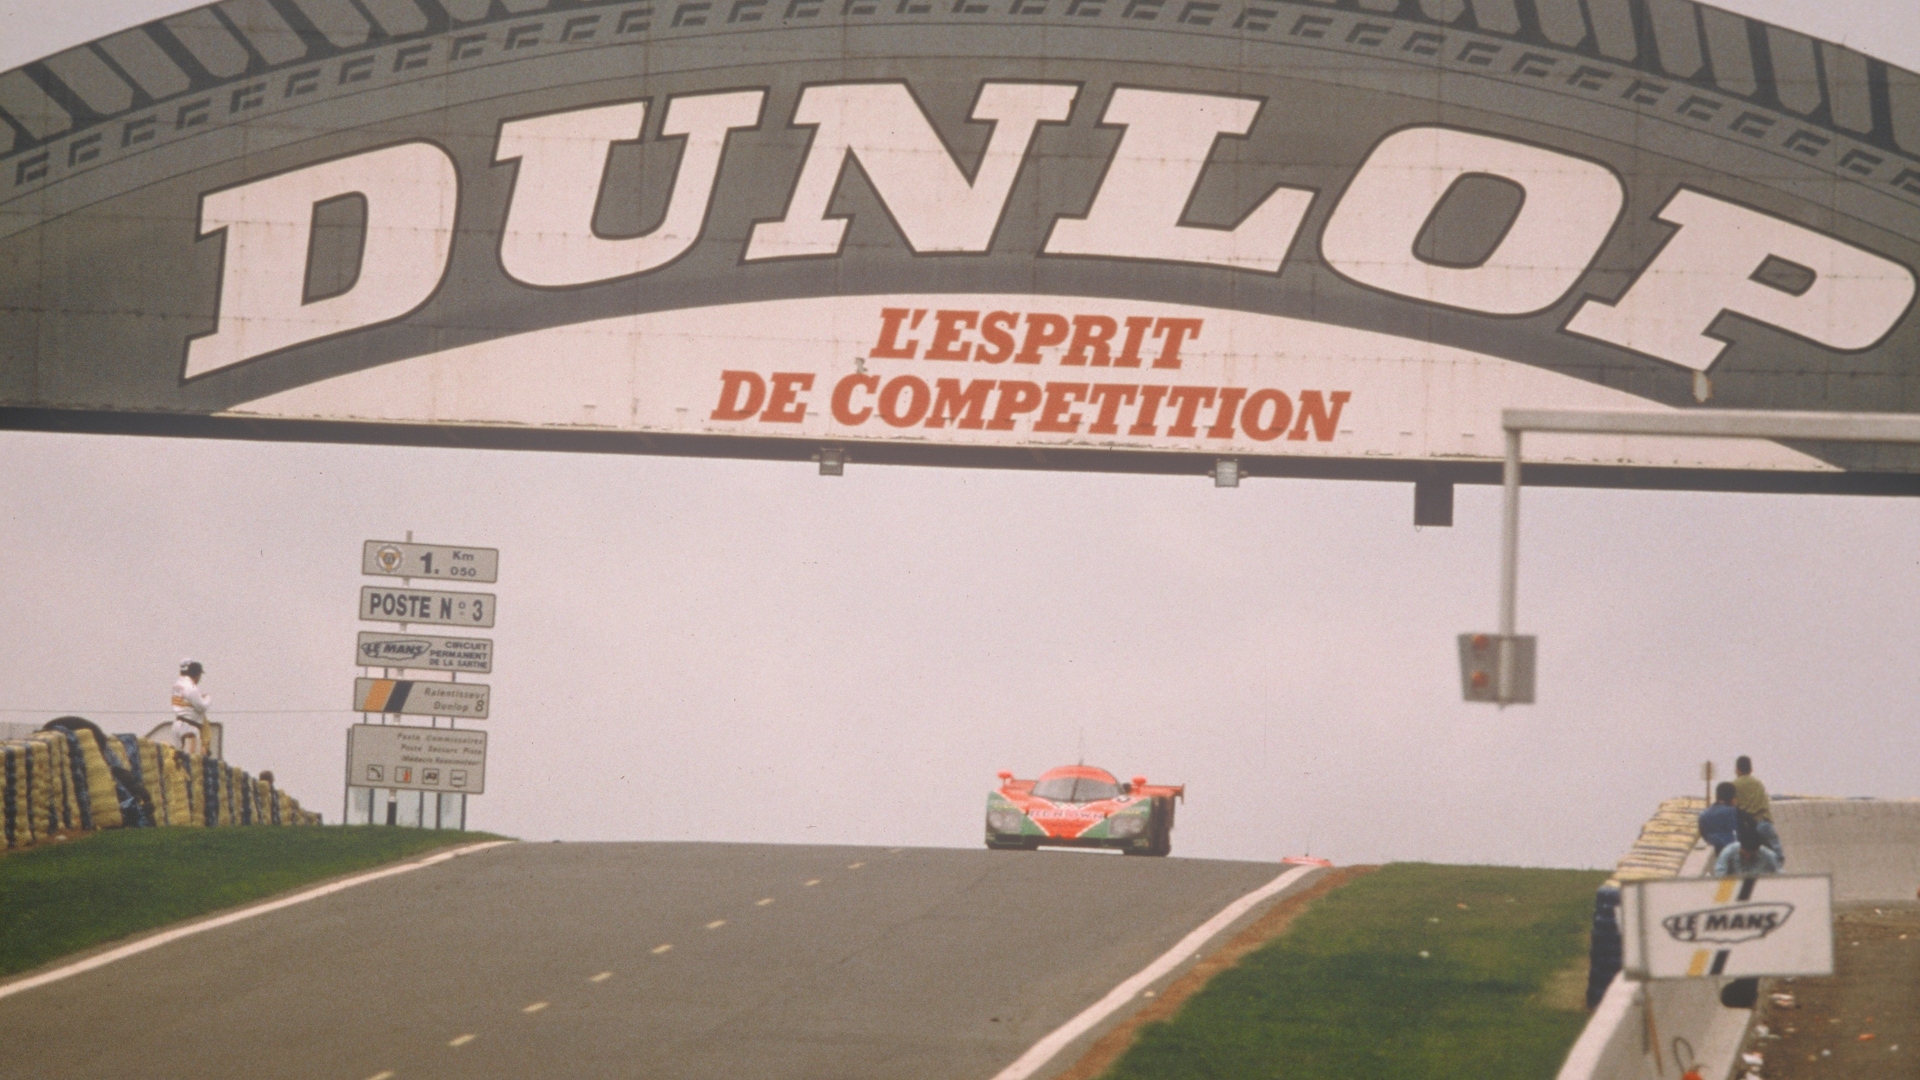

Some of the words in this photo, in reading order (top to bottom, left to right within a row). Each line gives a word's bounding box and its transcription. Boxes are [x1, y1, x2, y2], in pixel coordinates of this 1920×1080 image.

[182, 79, 1917, 381] DUNLOP
[869, 307, 1203, 369] L'ESPRIT
[710, 370, 815, 424] DE
[830, 374, 1351, 442] COMPETITION
[452, 551, 474, 560] Km
[450, 566, 476, 577] 050
[369, 593, 431, 618] POSTE
[472, 599, 483, 621] 3
[384, 644, 422, 655] MANS
[445, 641, 488, 650] CIRCUIT
[430, 650, 488, 660] PERMANENT
[475, 699, 485, 712] 8
[1703, 911, 1778, 933] MANS
